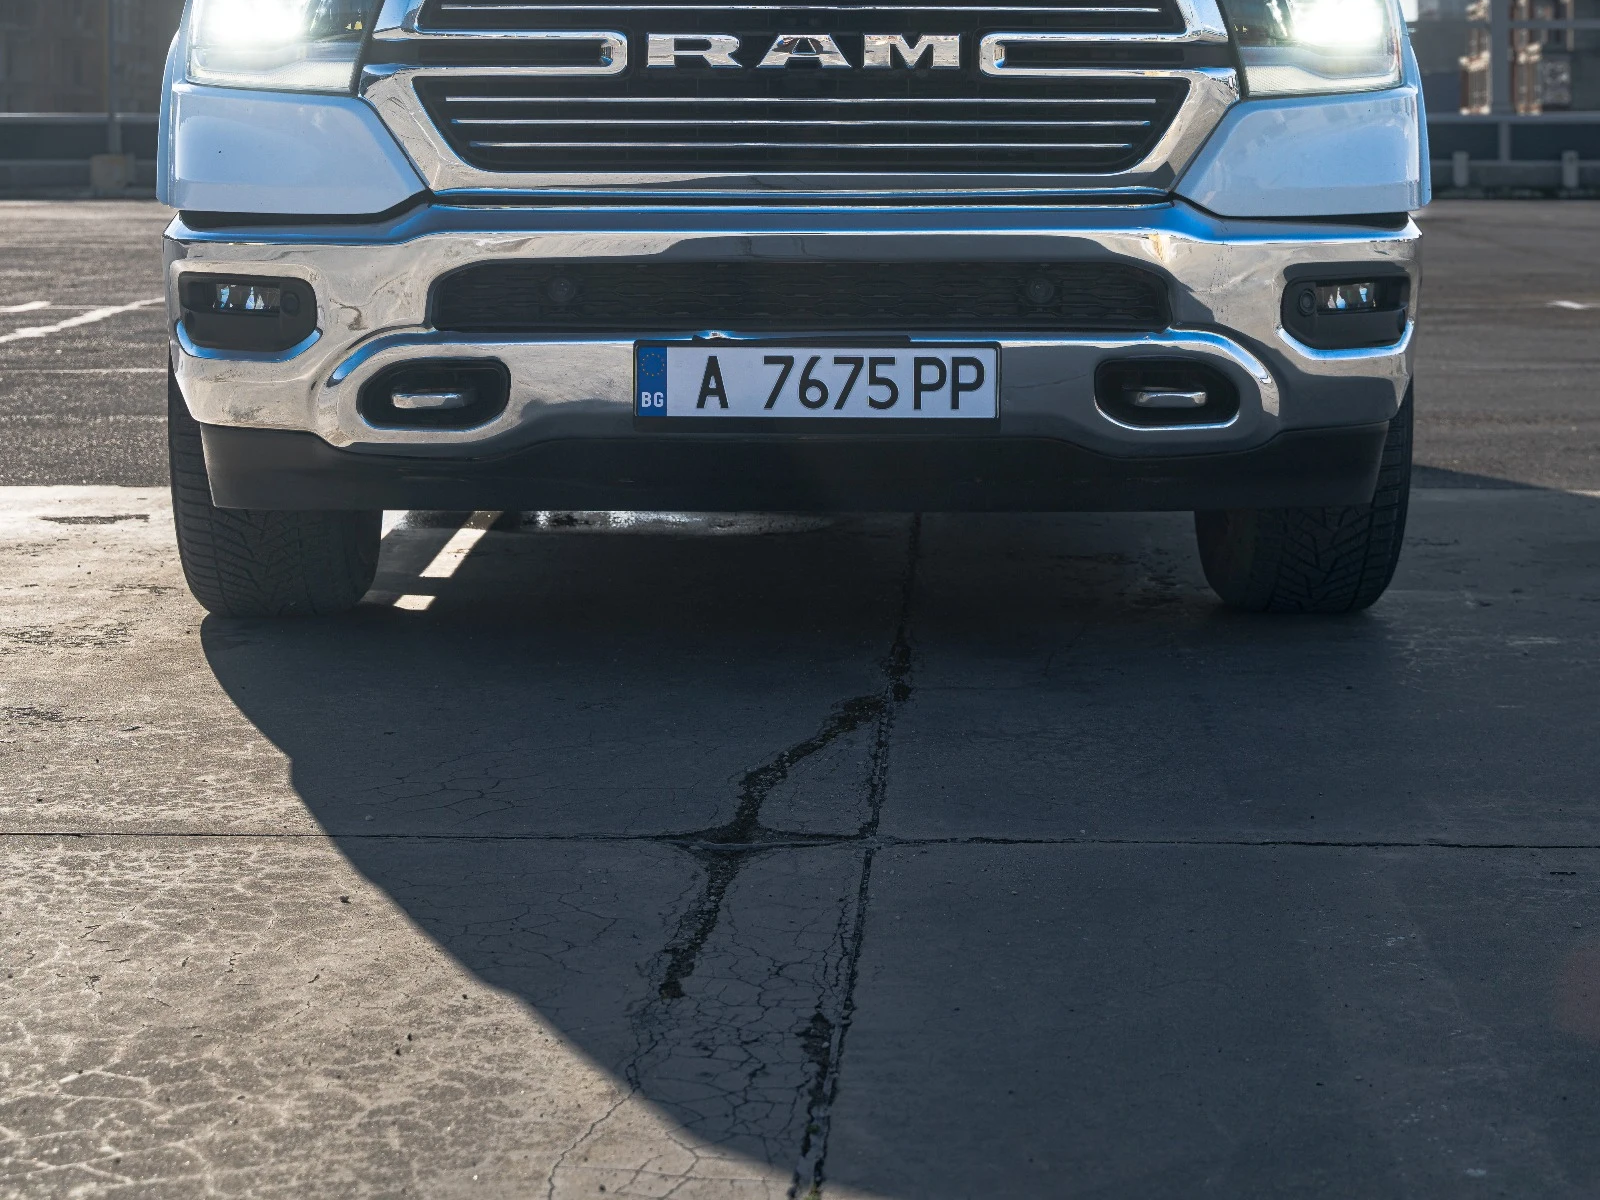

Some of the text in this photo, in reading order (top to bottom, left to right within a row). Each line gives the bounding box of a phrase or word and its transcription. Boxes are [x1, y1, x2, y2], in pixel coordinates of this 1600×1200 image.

[647, 33, 961, 69] RAM
[641, 392, 664, 407] BG
[696, 355, 729, 409] A
